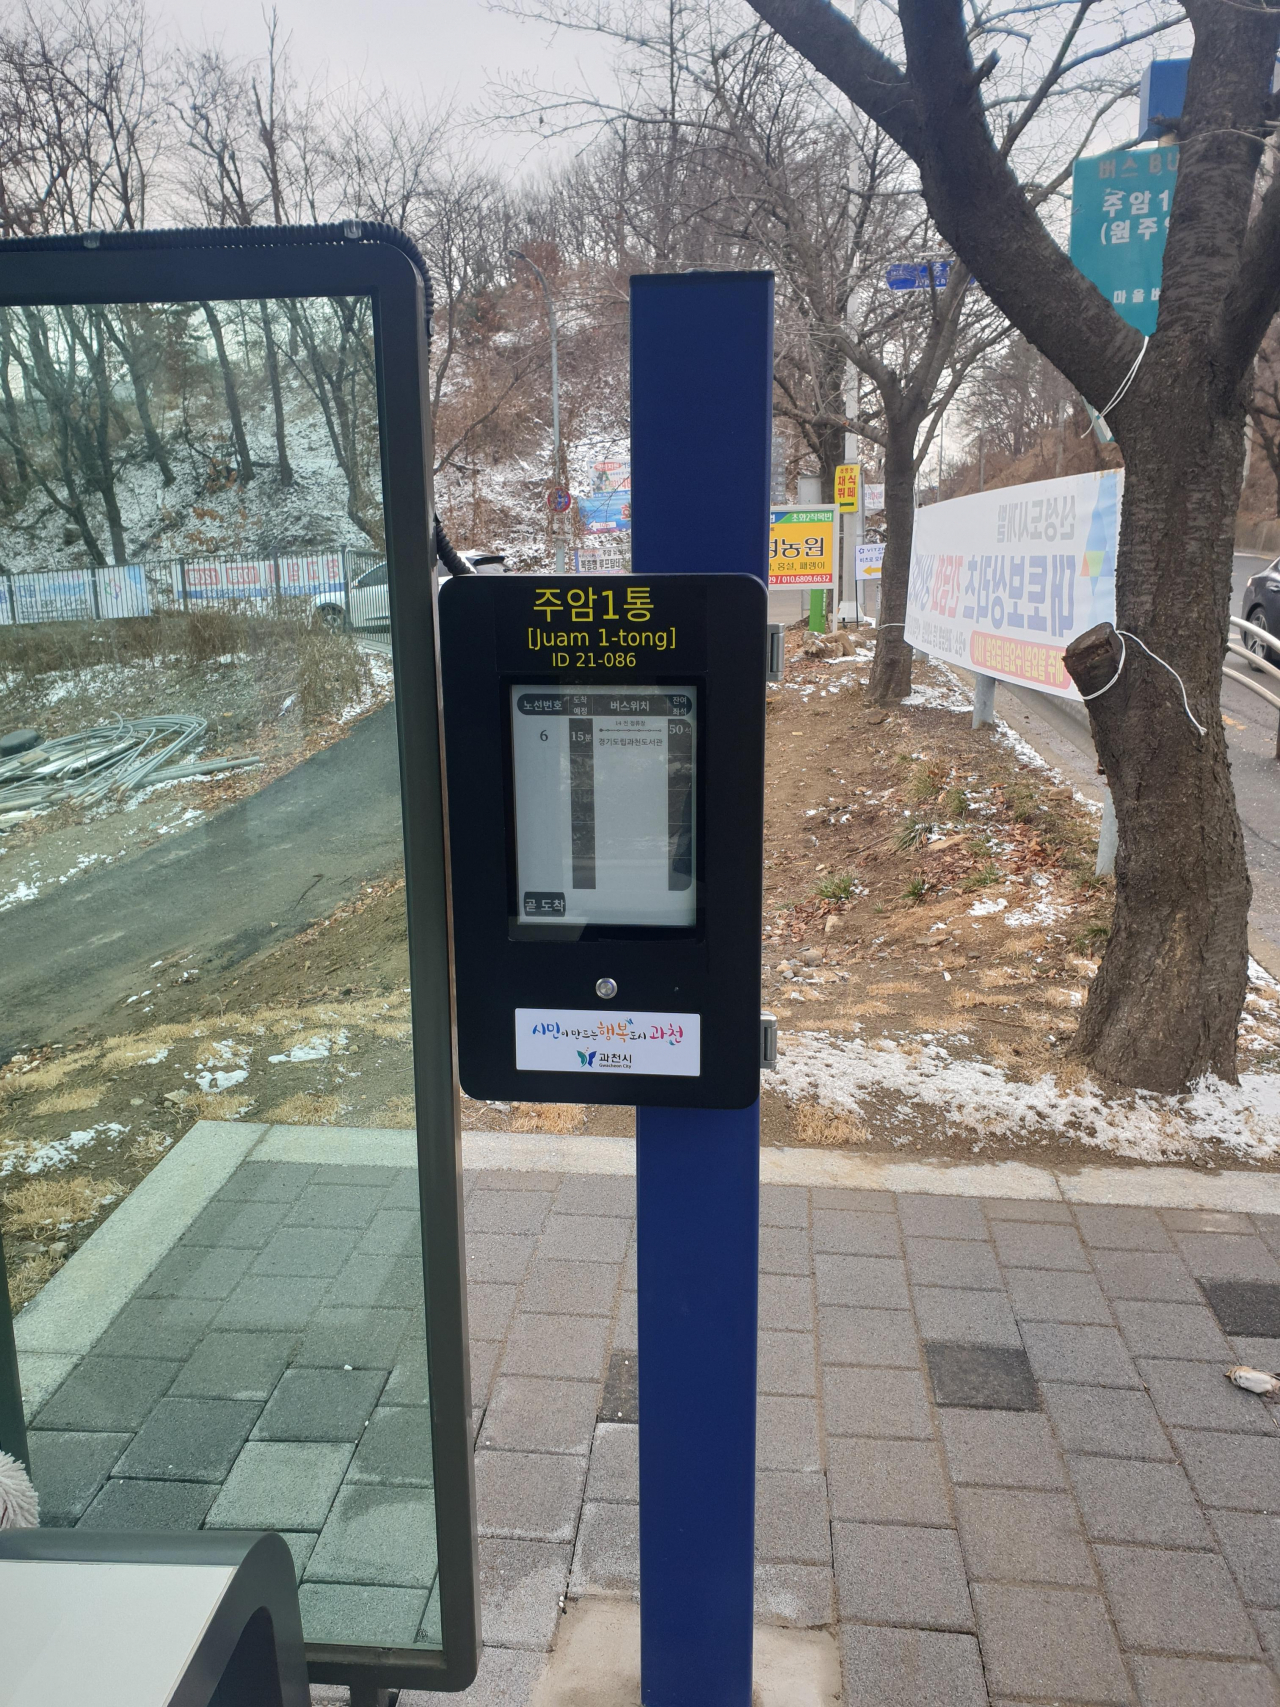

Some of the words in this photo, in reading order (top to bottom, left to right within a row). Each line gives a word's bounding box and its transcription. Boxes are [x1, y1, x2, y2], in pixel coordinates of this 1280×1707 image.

[1098, 156, 1138, 179] 버스
[1149, 152, 1180, 174] BU
[1103, 189, 1170, 218] 주암1
[782, 575, 830, 583] 010.6809.6632
[533, 587, 654, 622] 주암1통
[528, 628, 589, 650] [Juam
[598, 627, 677, 650] 1-tong]
[552, 653, 570, 667] ID
[576, 653, 637, 667] 21-086
[523, 700, 563, 711] 노선번호
[573, 696, 587, 704] 도착
[610, 700, 650, 712] 버스위치
[672, 696, 687, 705] 잔여
[573, 708, 588, 716] 예정
[539, 729, 549, 742] 6
[598, 738, 663, 747] 경기도립과천도서관
[524, 899, 537, 911] 곧
[540, 899, 565, 912] 도착
[571, 1028, 599, 1041] 만드는
[649, 1023, 683, 1044] 과천
[599, 1053, 632, 1064] 과천시
